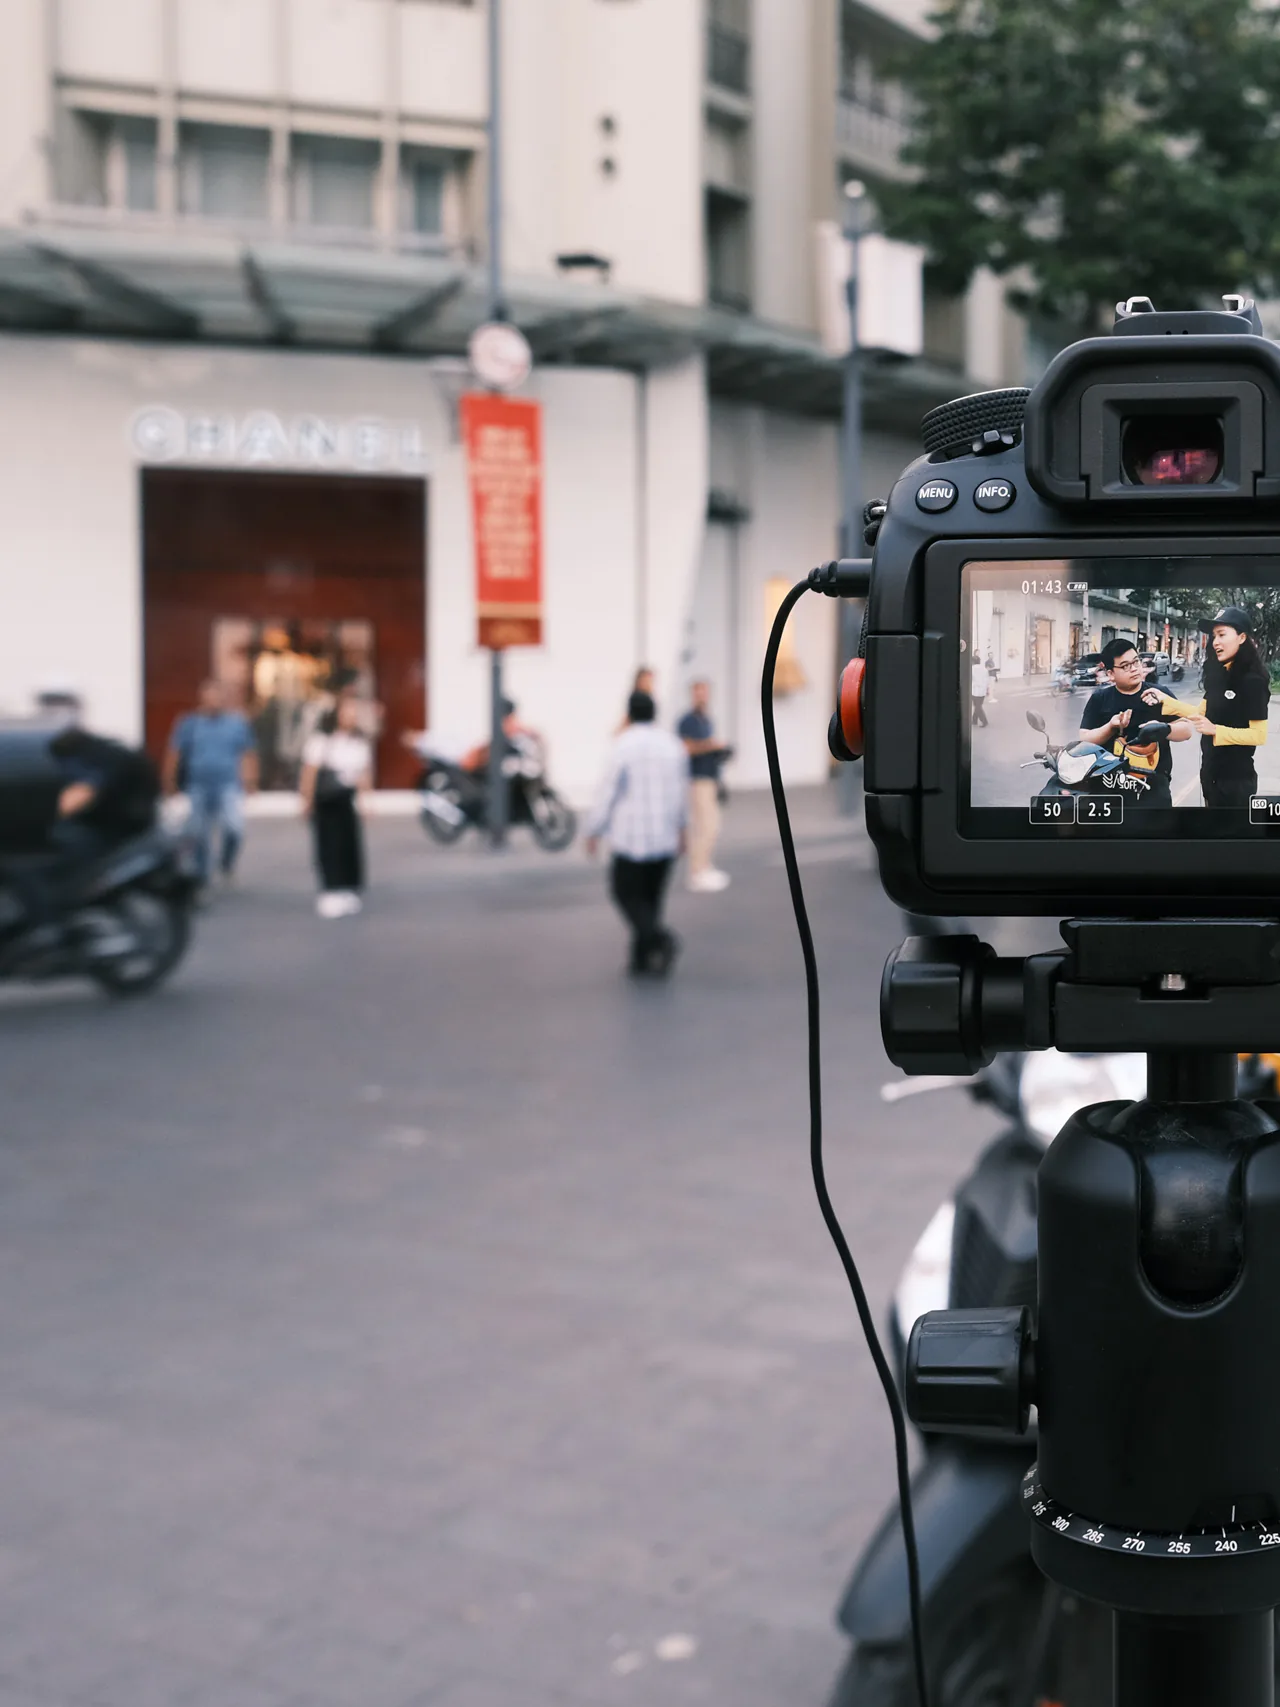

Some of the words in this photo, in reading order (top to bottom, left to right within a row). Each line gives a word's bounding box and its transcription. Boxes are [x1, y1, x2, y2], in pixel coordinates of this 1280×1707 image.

[131, 405, 430, 471] CHANEL
[919, 487, 953, 499] MENU
[978, 486, 1011, 498] INFO.
[1021, 579, 1062, 594] 01:43
[1043, 802, 1061, 817] 50
[1088, 802, 1111, 817] 2.5
[1252, 799, 1267, 809] ISO
[1032, 1501, 1047, 1517] 315
[1051, 1516, 1070, 1532] 300
[1082, 1528, 1105, 1544] 285
[1121, 1537, 1146, 1552] 270
[1167, 1541, 1191, 1554] 255
[1215, 1540, 1238, 1552] 240
